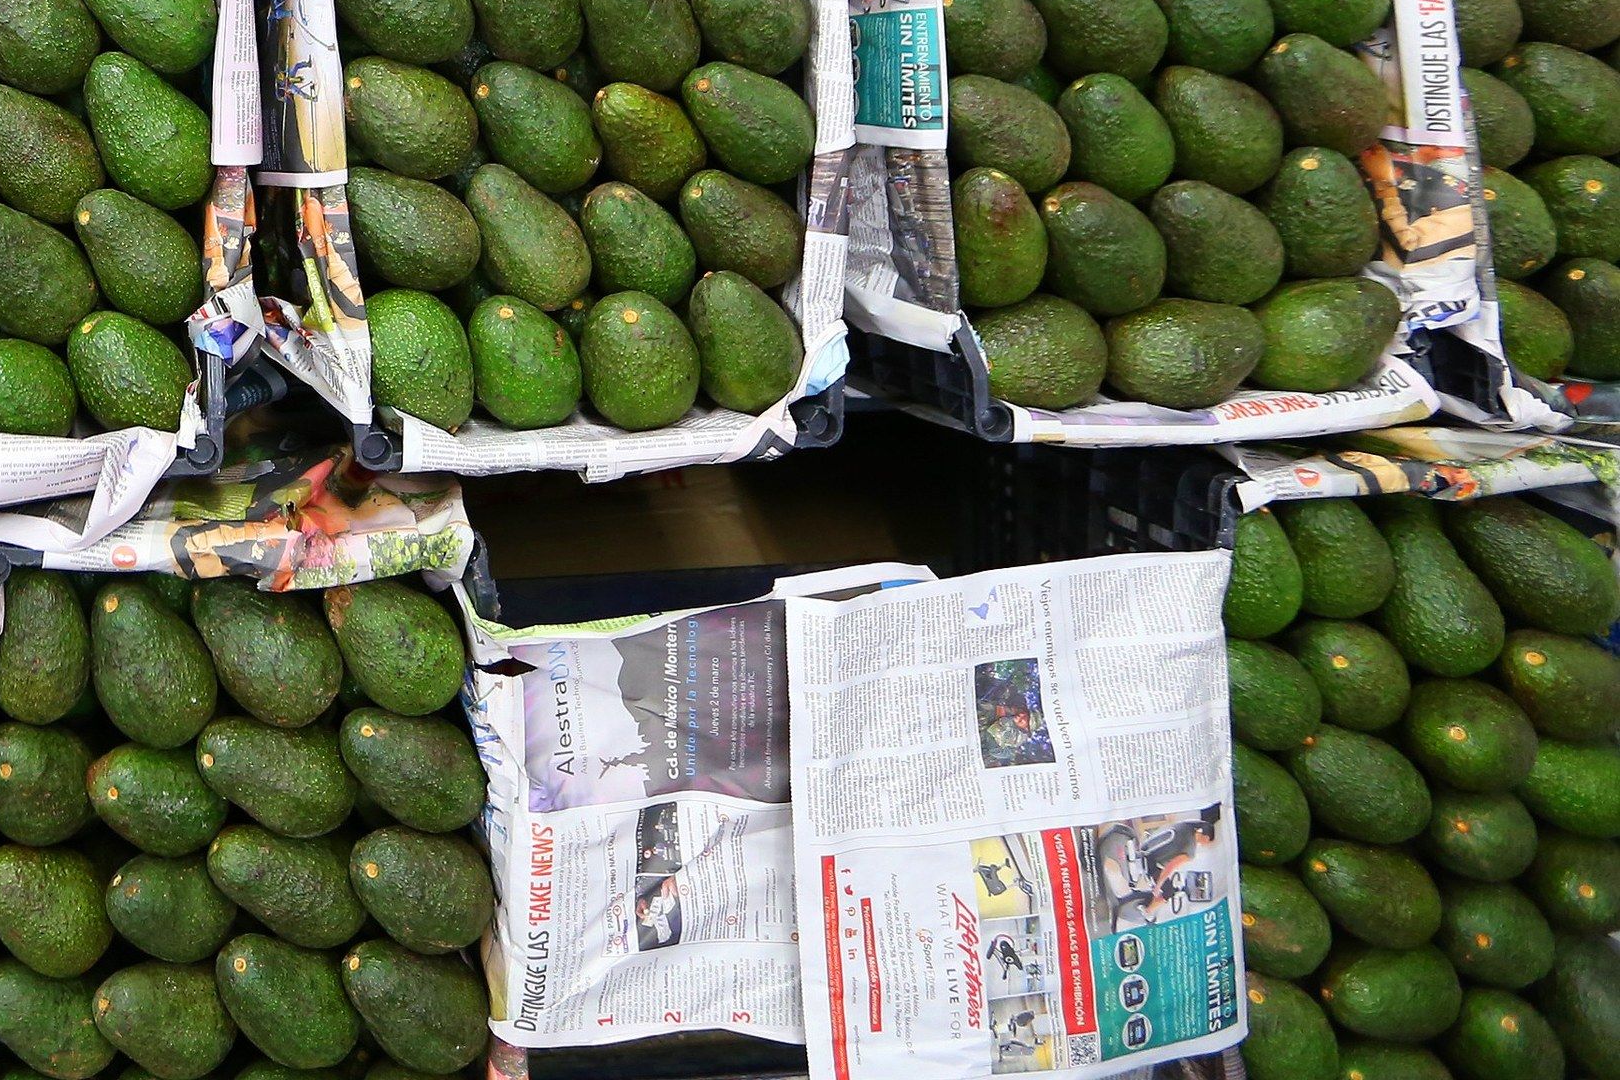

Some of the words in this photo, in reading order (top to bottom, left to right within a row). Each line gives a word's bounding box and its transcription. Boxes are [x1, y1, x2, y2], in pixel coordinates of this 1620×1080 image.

[899, 13, 913, 46] SIN
[1420, 20, 1447, 48] LAS
[916, 12, 933, 121] ENTRENAMIENTO
[900, 52, 917, 129] LÍMITES
[1419, 53, 1454, 132] DISTINGUE
[1037, 579, 1055, 618] Viejos
[1040, 621, 1058, 679] enemigos
[686, 691, 696, 701] la
[710, 686, 718, 698] de
[1049, 682, 1059, 696] se
[660, 685, 678, 728] México
[687, 707, 699, 728] por
[710, 708, 719, 736] Jueves
[578, 712, 587, 751] Business
[1051, 698, 1072, 750] vuelven
[664, 732, 678, 749] de
[1066, 753, 1082, 801] vecinos
[1053, 833, 1066, 865] VISITA
[936, 883, 950, 928] WHAT
[1060, 867, 1075, 919] NUESTRAS
[1066, 920, 1078, 952] SALAS
[1202, 911, 1219, 947] SIN
[528, 931, 549, 960] LAS
[943, 937, 955, 959] WE
[1070, 953, 1079, 967] DE
[868, 956, 878, 983] Mérida
[947, 968, 959, 1004] LIVE
[1071, 968, 1087, 1026] EXHIBICIÓN
[1201, 953, 1228, 1032] LÍMITES
[597, 1014, 613, 1026] 1
[664, 1011, 681, 1023] 2
[732, 1011, 751, 1023] 3
[950, 1011, 961, 1040] FOR
